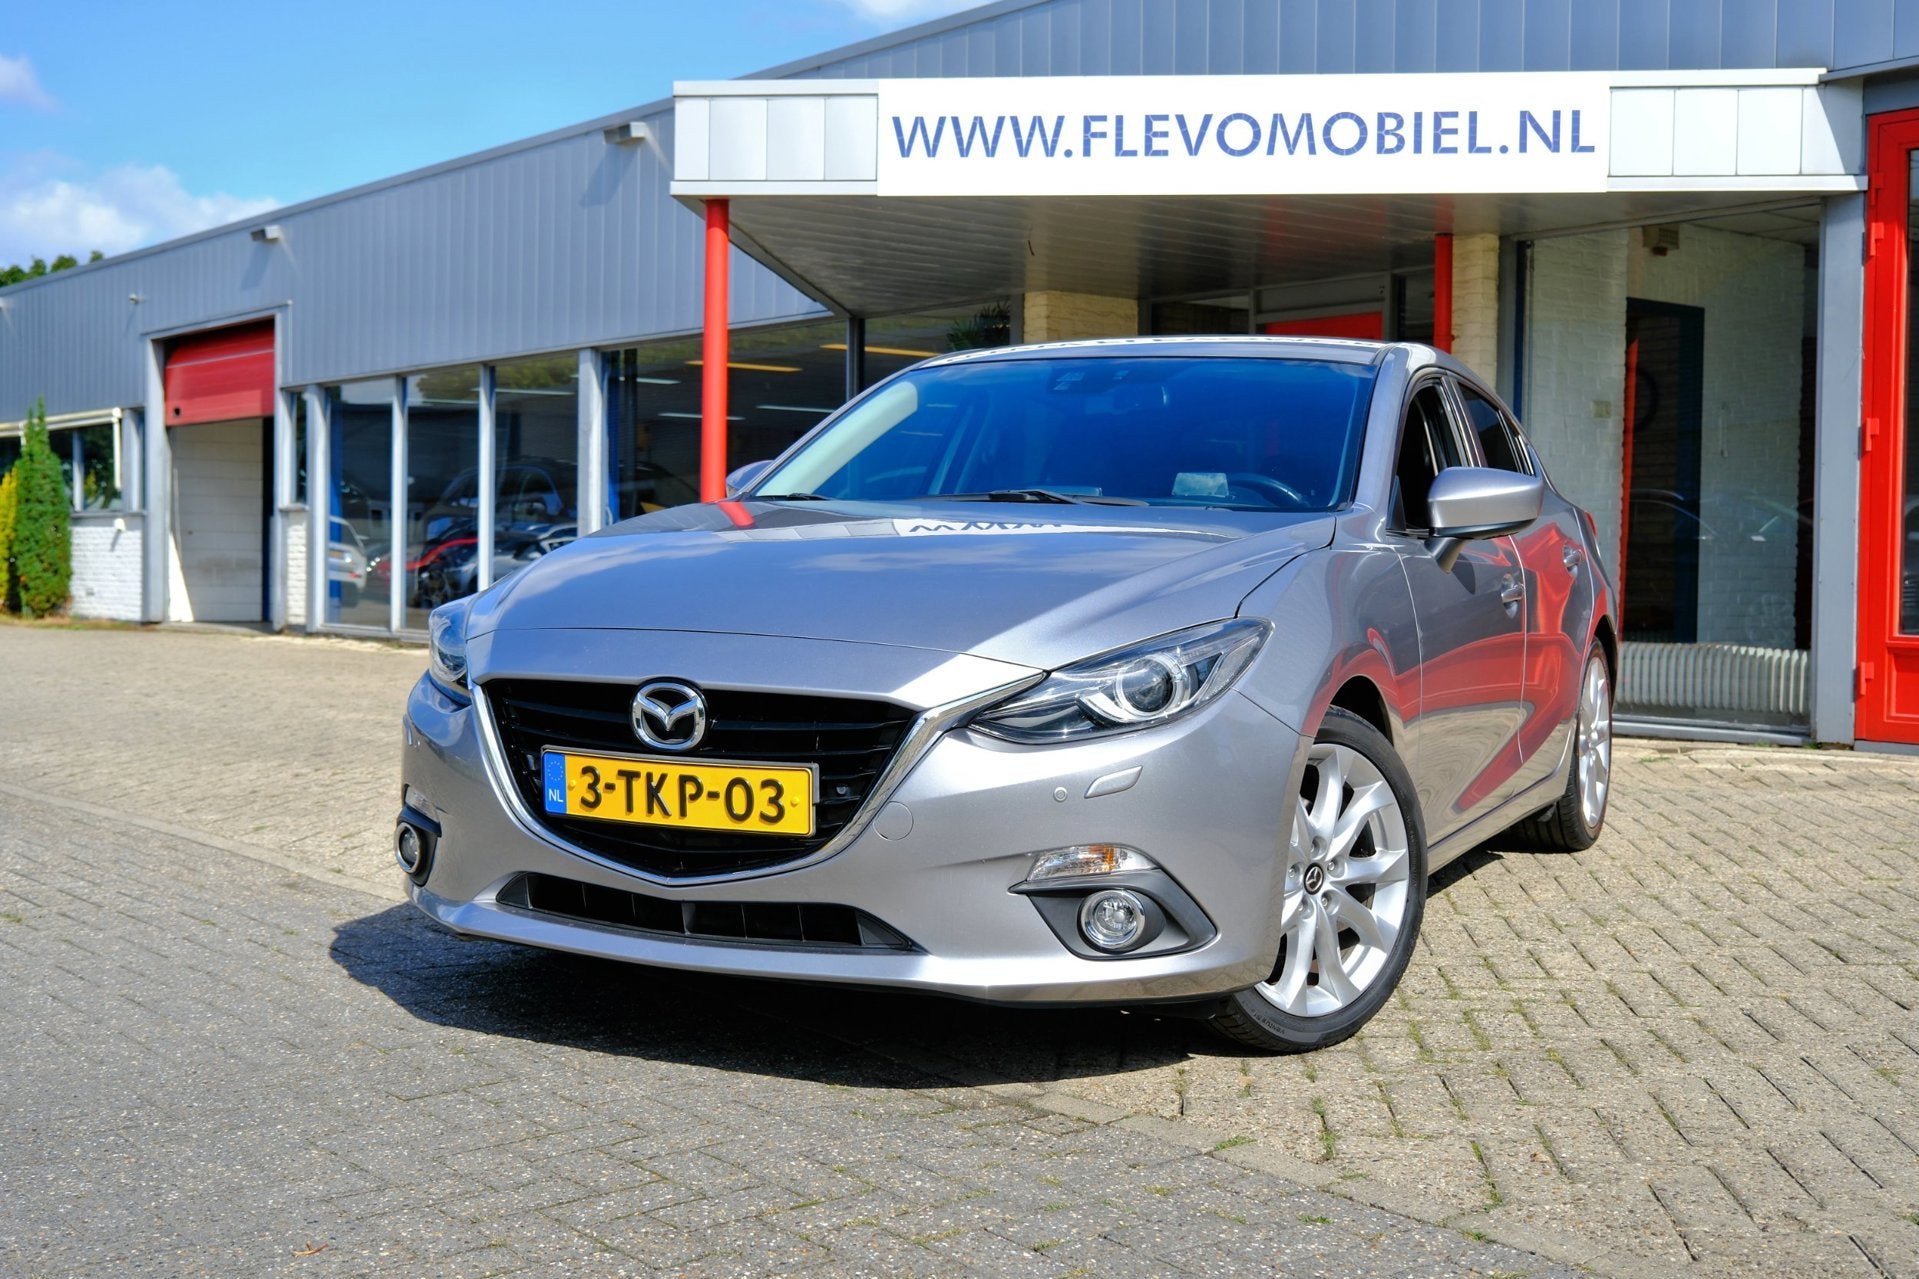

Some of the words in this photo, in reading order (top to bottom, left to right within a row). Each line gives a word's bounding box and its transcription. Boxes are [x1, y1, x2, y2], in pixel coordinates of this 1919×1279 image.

[892, 110, 1596, 158] WWW.FLEVOMOBIEL.NL
[548, 788, 564, 803] NL
[580, 765, 786, 824] 3-TKP-03
